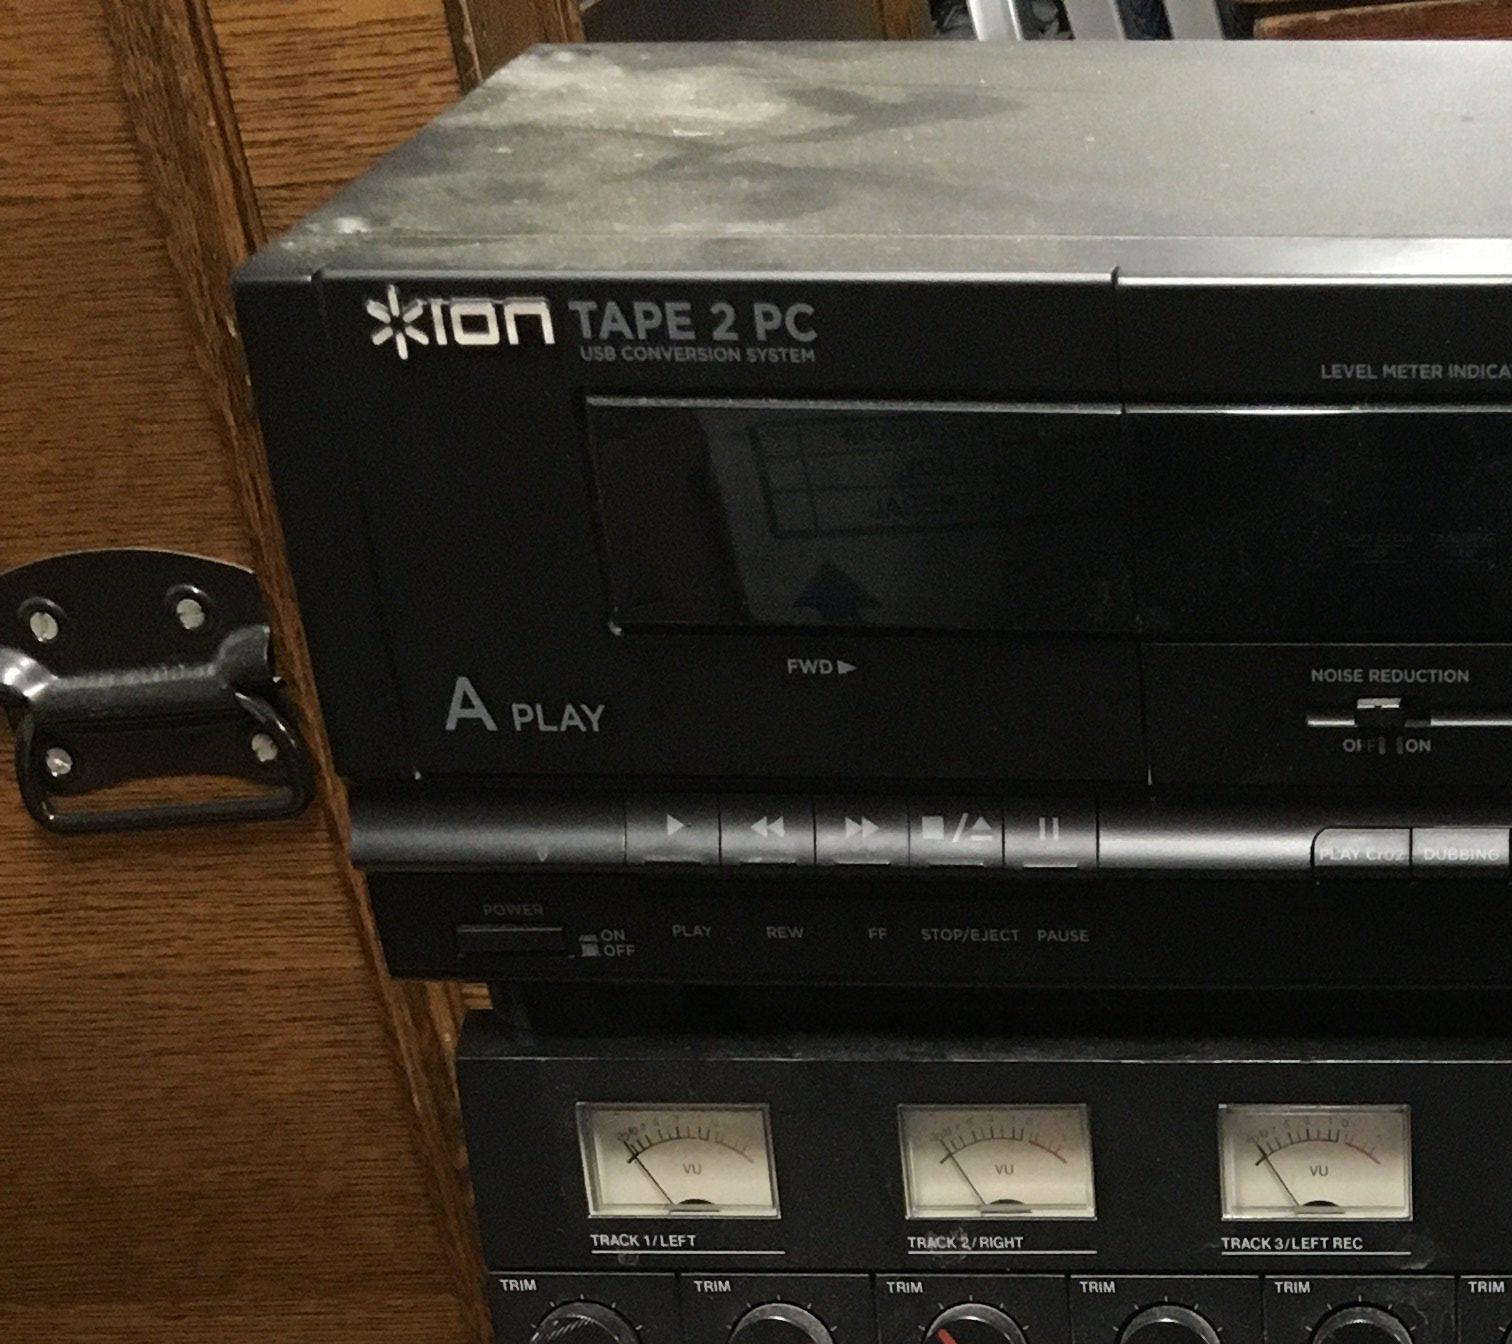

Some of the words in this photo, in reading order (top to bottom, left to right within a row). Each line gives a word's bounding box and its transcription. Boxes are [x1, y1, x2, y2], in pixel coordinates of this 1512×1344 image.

[568, 301, 695, 340] TAPE
[710, 302, 738, 340] 2
[754, 303, 817, 342] PC
[580, 345, 616, 361] USB
[621, 345, 741, 362] CONVERSION
[746, 347, 815, 363] SYSTEM
[1321, 364, 1377, 379] LEVEL
[1383, 364, 1442, 379] METER
[787, 659, 833, 674] FWD
[1311, 669, 1363, 682] NOISE
[1369, 669, 1469, 683] REDUCTION
[446, 677, 497, 731] A
[512, 703, 604, 731] PLAY
[1423, 847, 1500, 862] DUBBING
[483, 905, 543, 916] POWER
[672, 924, 711, 937] PLAY
[766, 926, 803, 938] REW
[868, 927, 887, 939] FF
[921, 928, 1018, 942] STOP/EJECT
[1037, 930, 1089, 942] PAUSE
[683, 1164, 702, 1176] VU
[590, 1234, 639, 1246] TRACK
[908, 1236, 956, 1248] TRACK
[1221, 1237, 1271, 1250] TRACK
[1275, 1237, 1329, 1250] 3/LEFT
[1333, 1237, 1362, 1249] REC
[500, 1279, 536, 1291] TRIM
